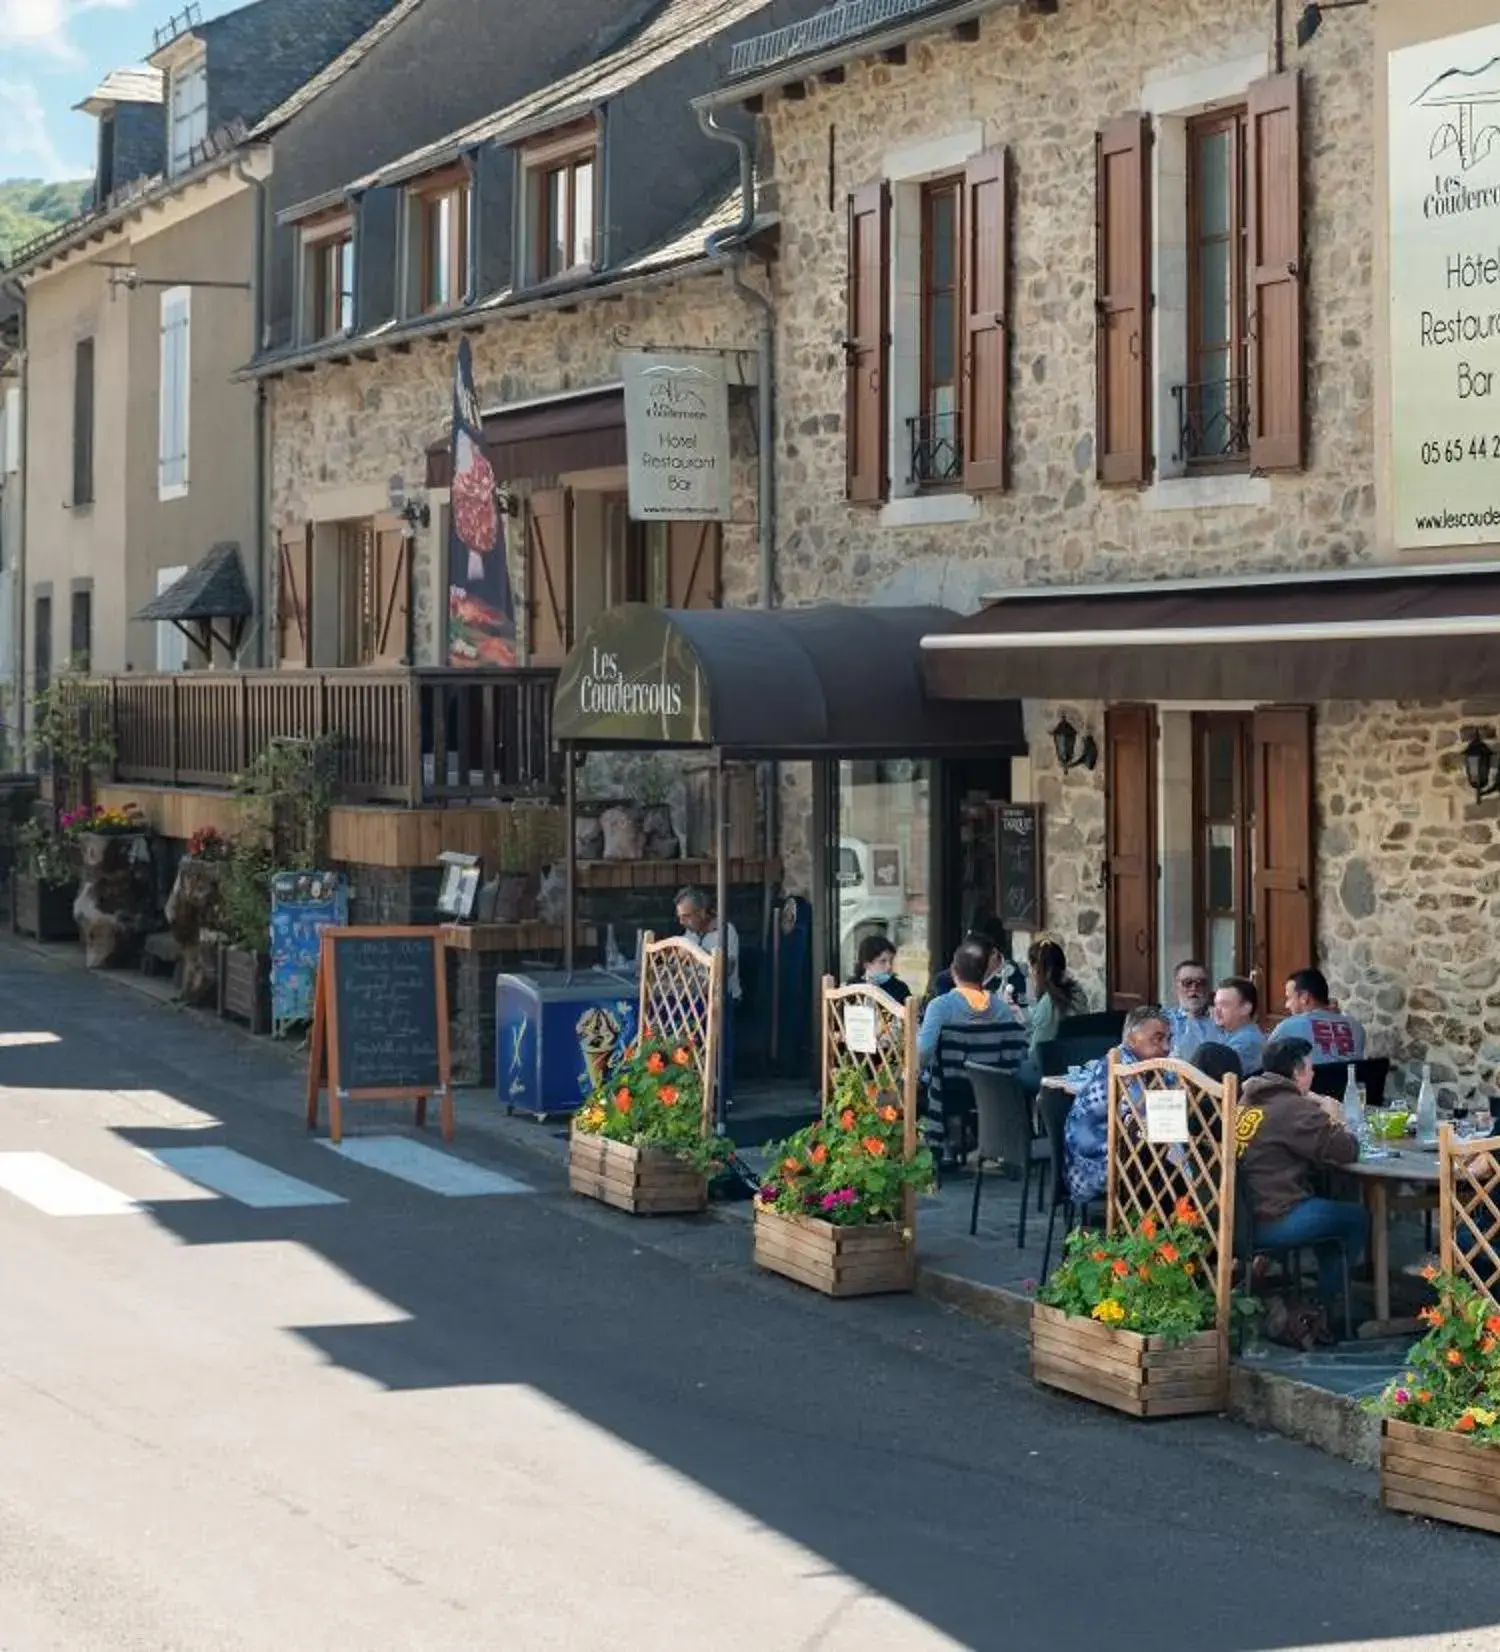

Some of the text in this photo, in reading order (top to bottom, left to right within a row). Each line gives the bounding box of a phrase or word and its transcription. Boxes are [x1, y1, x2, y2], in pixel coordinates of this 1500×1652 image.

[1435, 175, 1461, 195] Les
[1457, 361, 1494, 399] Bar
[642, 452, 716, 470] Restaurant
[1421, 441, 1441, 465] 05
[1444, 438, 1463, 463] 65
[1468, 435, 1487, 461] 44
[593, 646, 618, 681] Les
[581, 672, 682, 716] Coudercous
